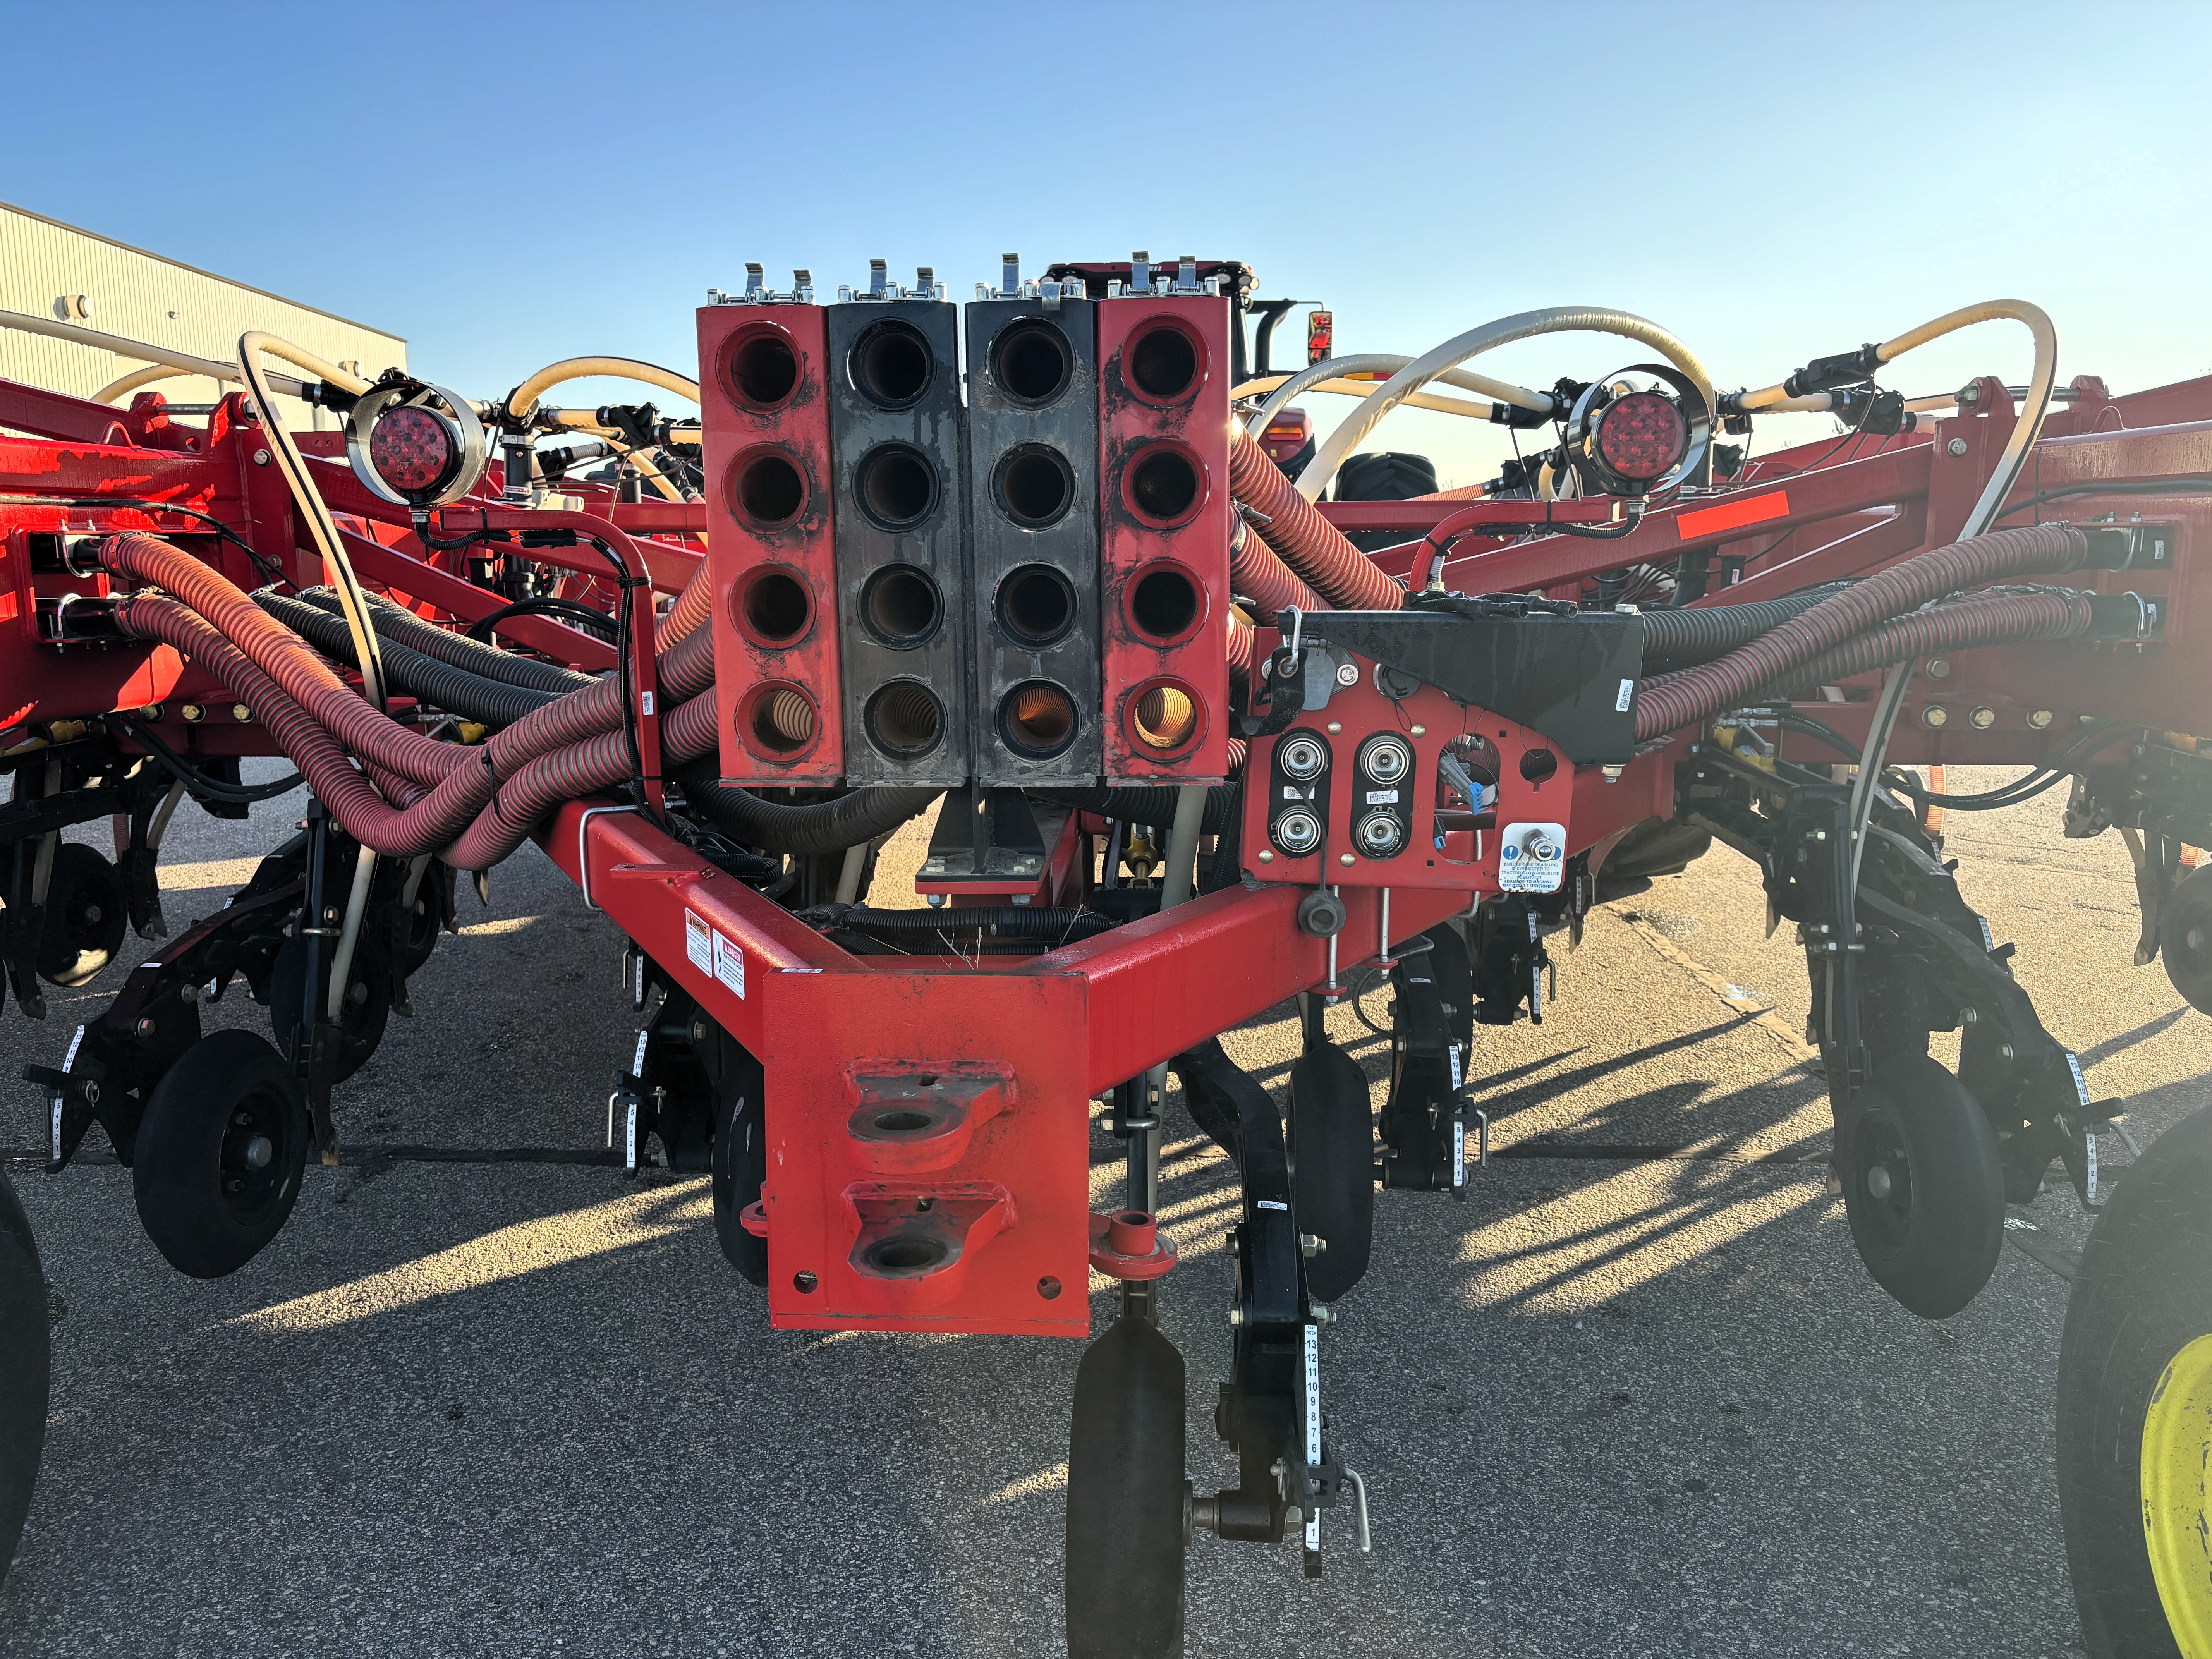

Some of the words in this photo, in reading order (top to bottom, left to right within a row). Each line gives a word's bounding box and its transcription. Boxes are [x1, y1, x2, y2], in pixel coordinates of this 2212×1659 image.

[727, 945, 741, 963] DANGER
[1307, 1340, 1316, 1348] 13
[1307, 1353, 1317, 1362] 12
[1308, 1367, 1316, 1376] 11
[1308, 1382, 1317, 1391] 10
[1310, 1397, 1316, 1406] 9
[1311, 1412, 1316, 1421] 8
[1311, 1428, 1316, 1437] 7
[1312, 1444, 1317, 1453] 6
[1311, 1528, 1315, 1537] 1
